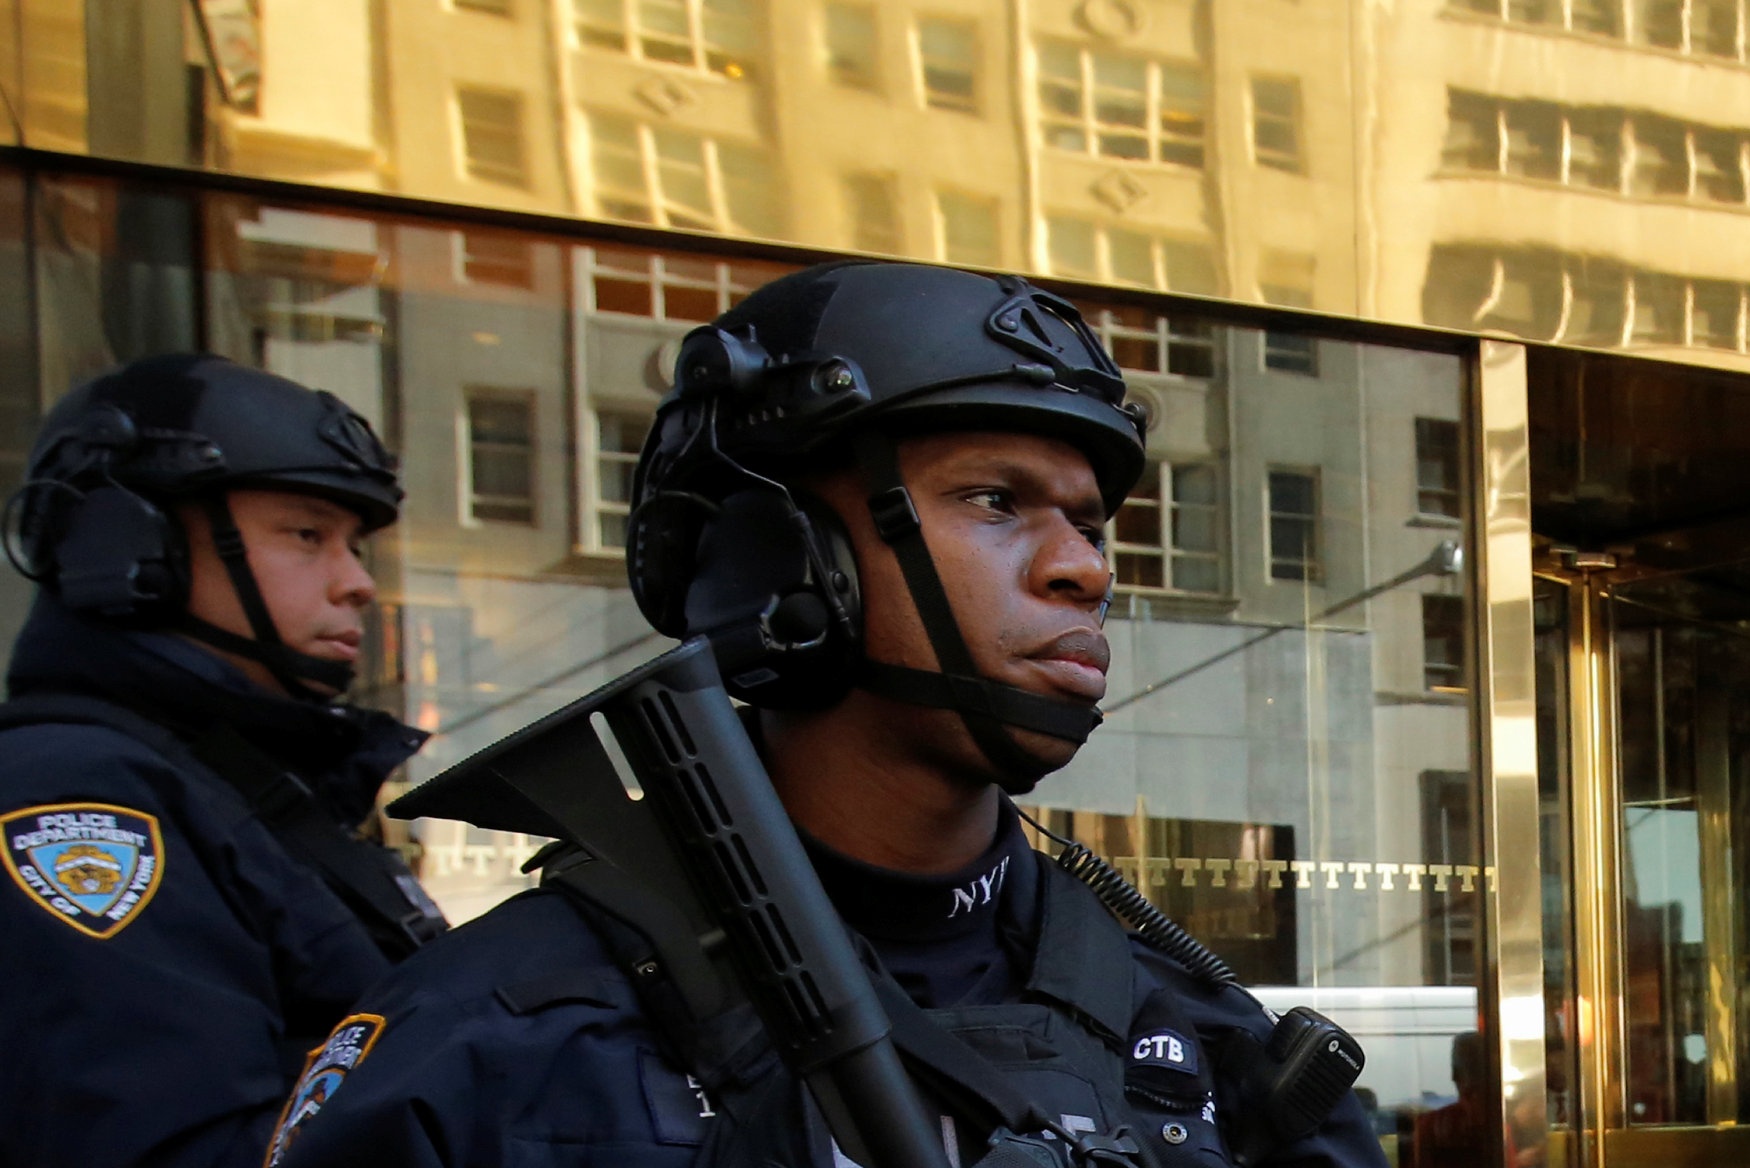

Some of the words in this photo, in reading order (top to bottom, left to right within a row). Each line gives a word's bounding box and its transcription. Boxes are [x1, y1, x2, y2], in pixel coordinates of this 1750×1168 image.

[37, 813, 118, 829] POLICE
[13, 826, 147, 850] DEPARTMENT
[19, 864, 57, 896] CITY
[51, 897, 81, 916] OF
[106, 890, 140, 921] NEW
[129, 854, 155, 890] YORK
[1133, 1035, 1185, 1063] CTB
